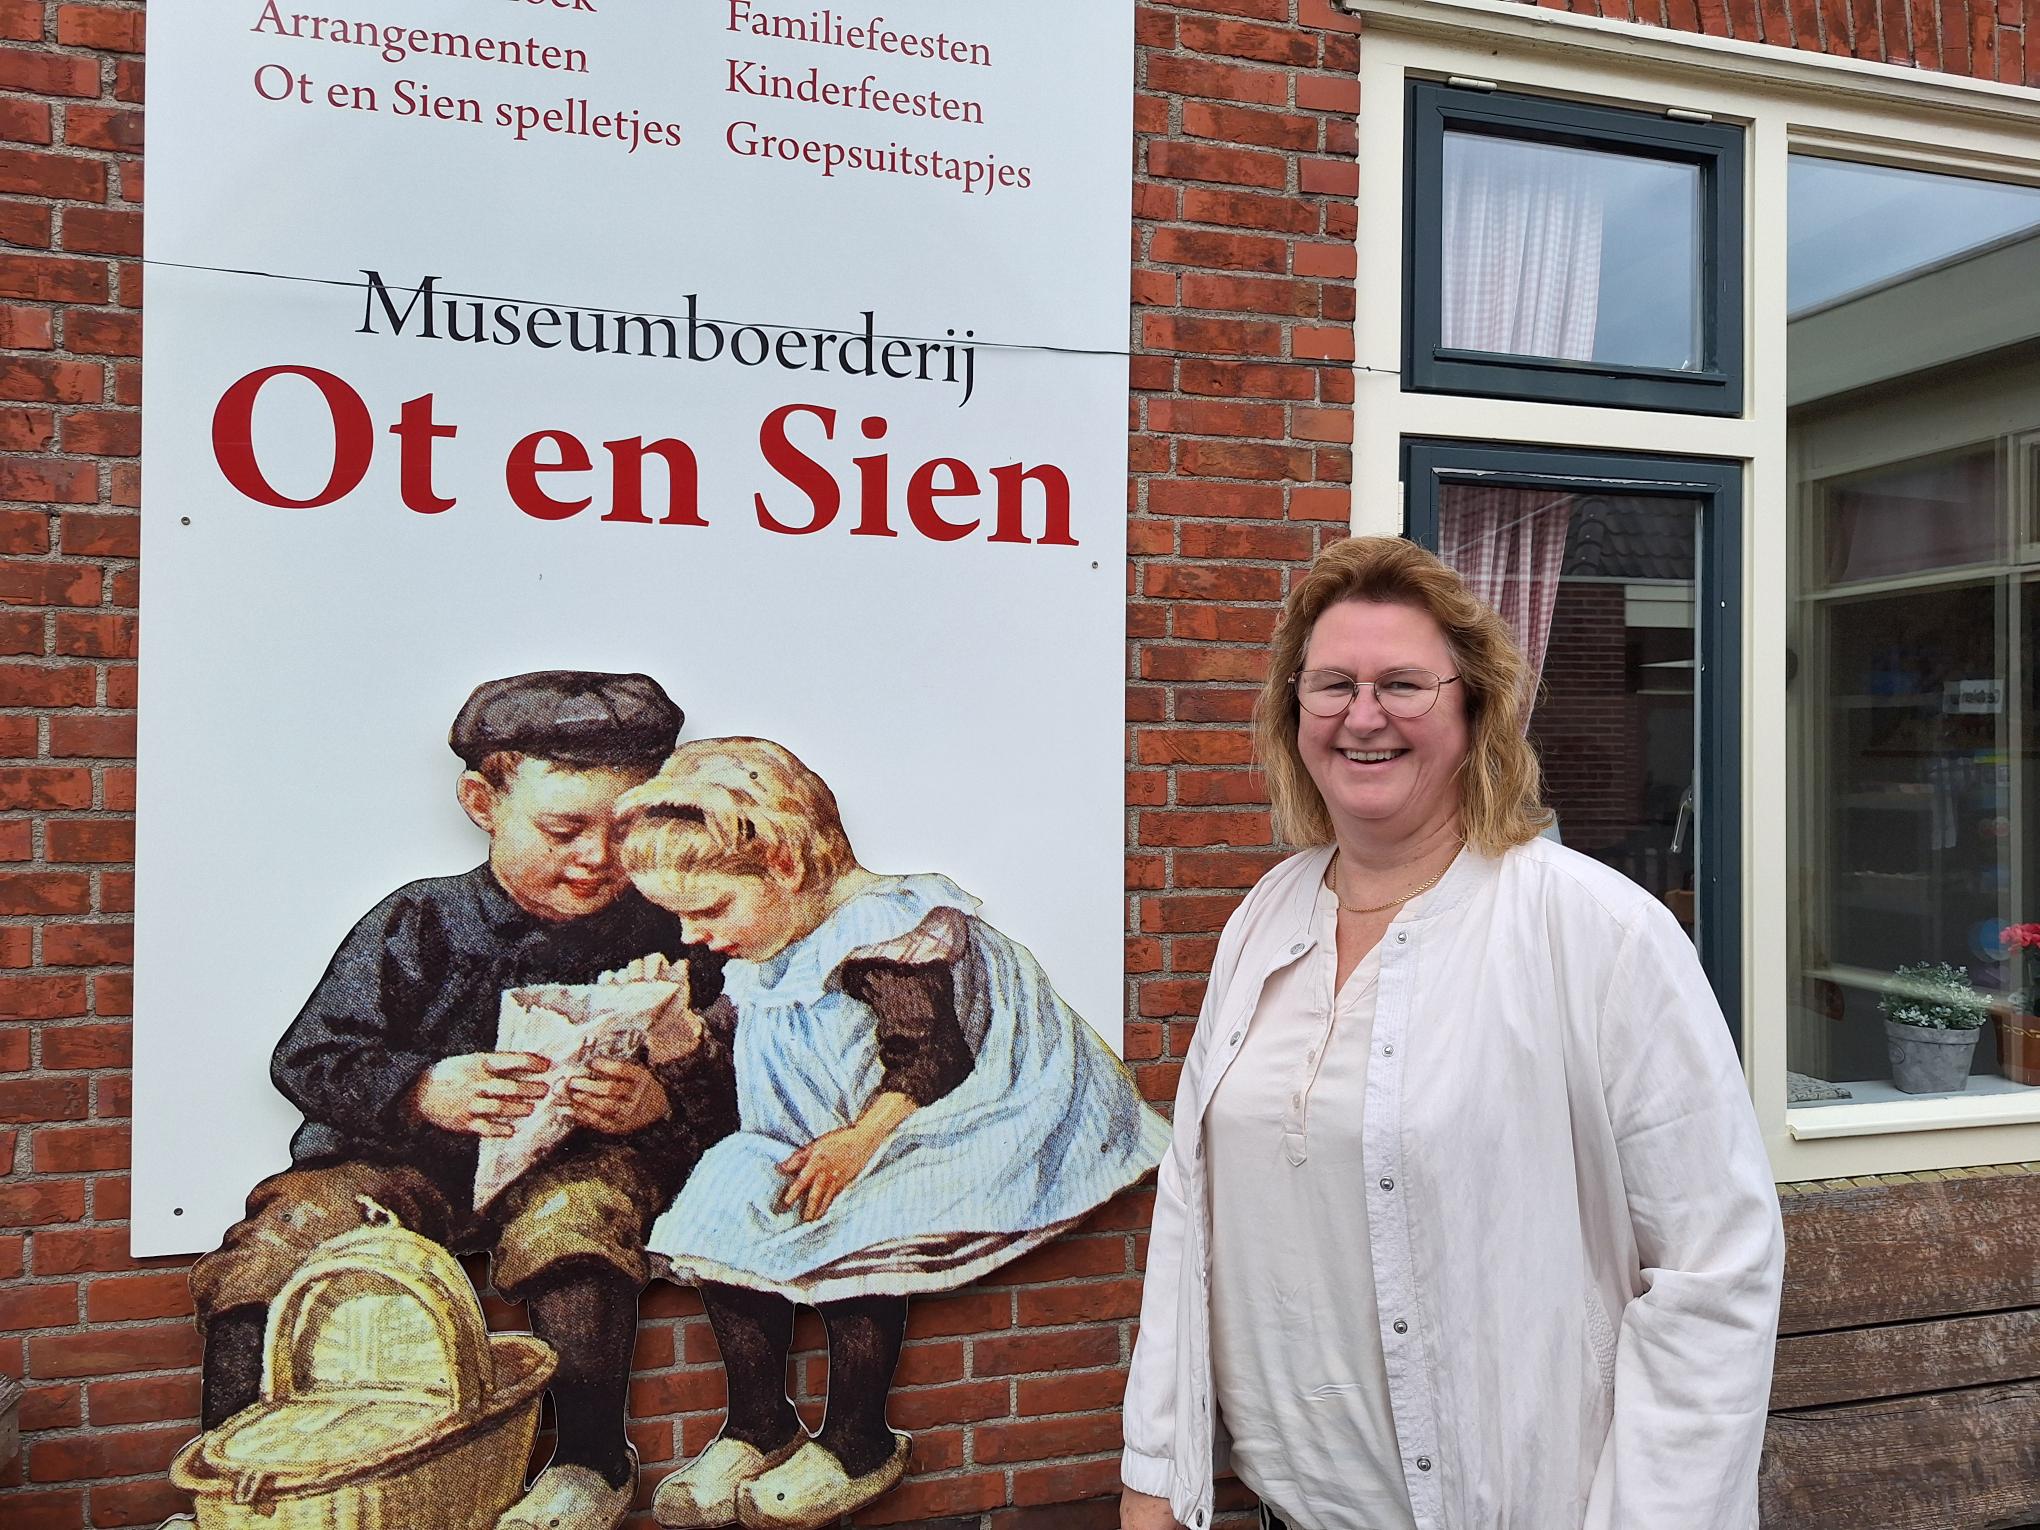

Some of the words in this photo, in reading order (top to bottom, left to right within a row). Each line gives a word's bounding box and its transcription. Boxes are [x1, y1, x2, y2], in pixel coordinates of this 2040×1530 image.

[250, 0, 590, 74] Arrangementen
[725, 0, 993, 67] Familiefeesten
[254, 64, 314, 105] Ot
[327, 83, 379, 112] en
[392, 79, 483, 124] Sien
[495, 97, 683, 155] spelletjes
[725, 58, 985, 125] Kinderfeesten
[726, 120, 1032, 197] Groepsuitstapjes
[356, 270, 977, 408] Museumboerderij
[211, 365, 458, 515] Ot
[505, 429, 710, 528] en
[753, 403, 1080, 547] Sien
